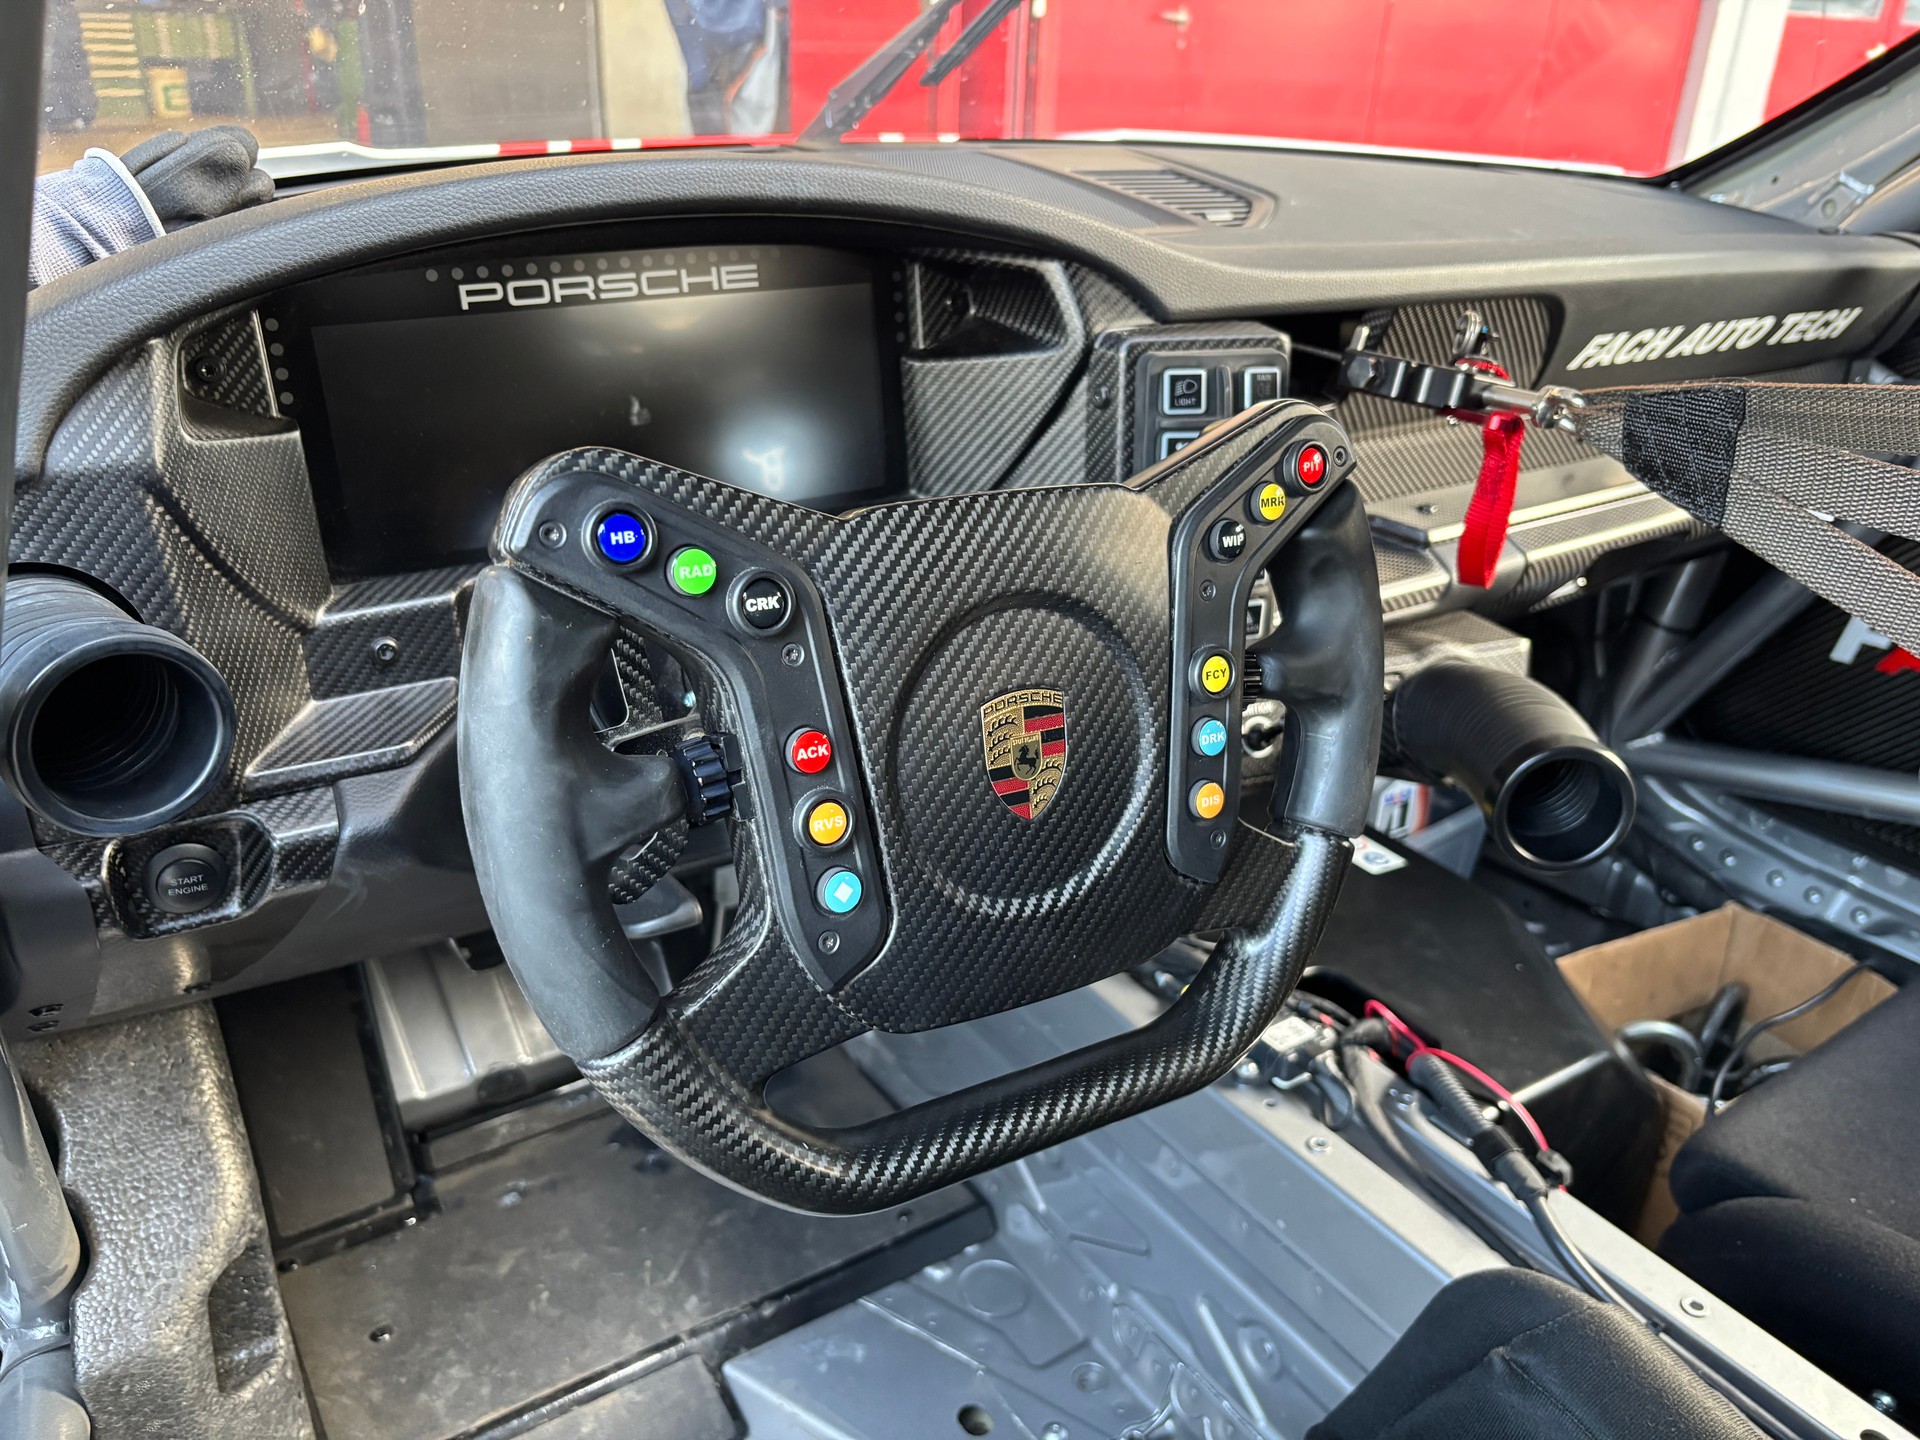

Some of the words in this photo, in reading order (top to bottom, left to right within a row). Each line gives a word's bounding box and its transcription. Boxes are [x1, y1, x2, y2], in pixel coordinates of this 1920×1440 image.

[458, 263, 760, 311] PORSCHE
[1566, 325, 1687, 371] FACH
[1665, 315, 1778, 359] AUTO
[1765, 306, 1864, 346] TECH
[1174, 398, 1197, 407] LIGHT
[1303, 461, 1321, 473] PIT
[1260, 495, 1285, 508] MRK
[609, 530, 636, 546] HB
[1221, 532, 1245, 548] WIP
[678, 564, 714, 580] RAD
[745, 595, 781, 612] CRK
[1205, 667, 1227, 681] FCY
[982, 690, 1064, 718] PORSCHE
[1201, 731, 1225, 746] DRK
[796, 743, 829, 761] ACK
[1201, 794, 1220, 808] DIS
[813, 815, 845, 833] RVS
[170, 875, 204, 886] START
[168, 884, 208, 895] ENGINE
